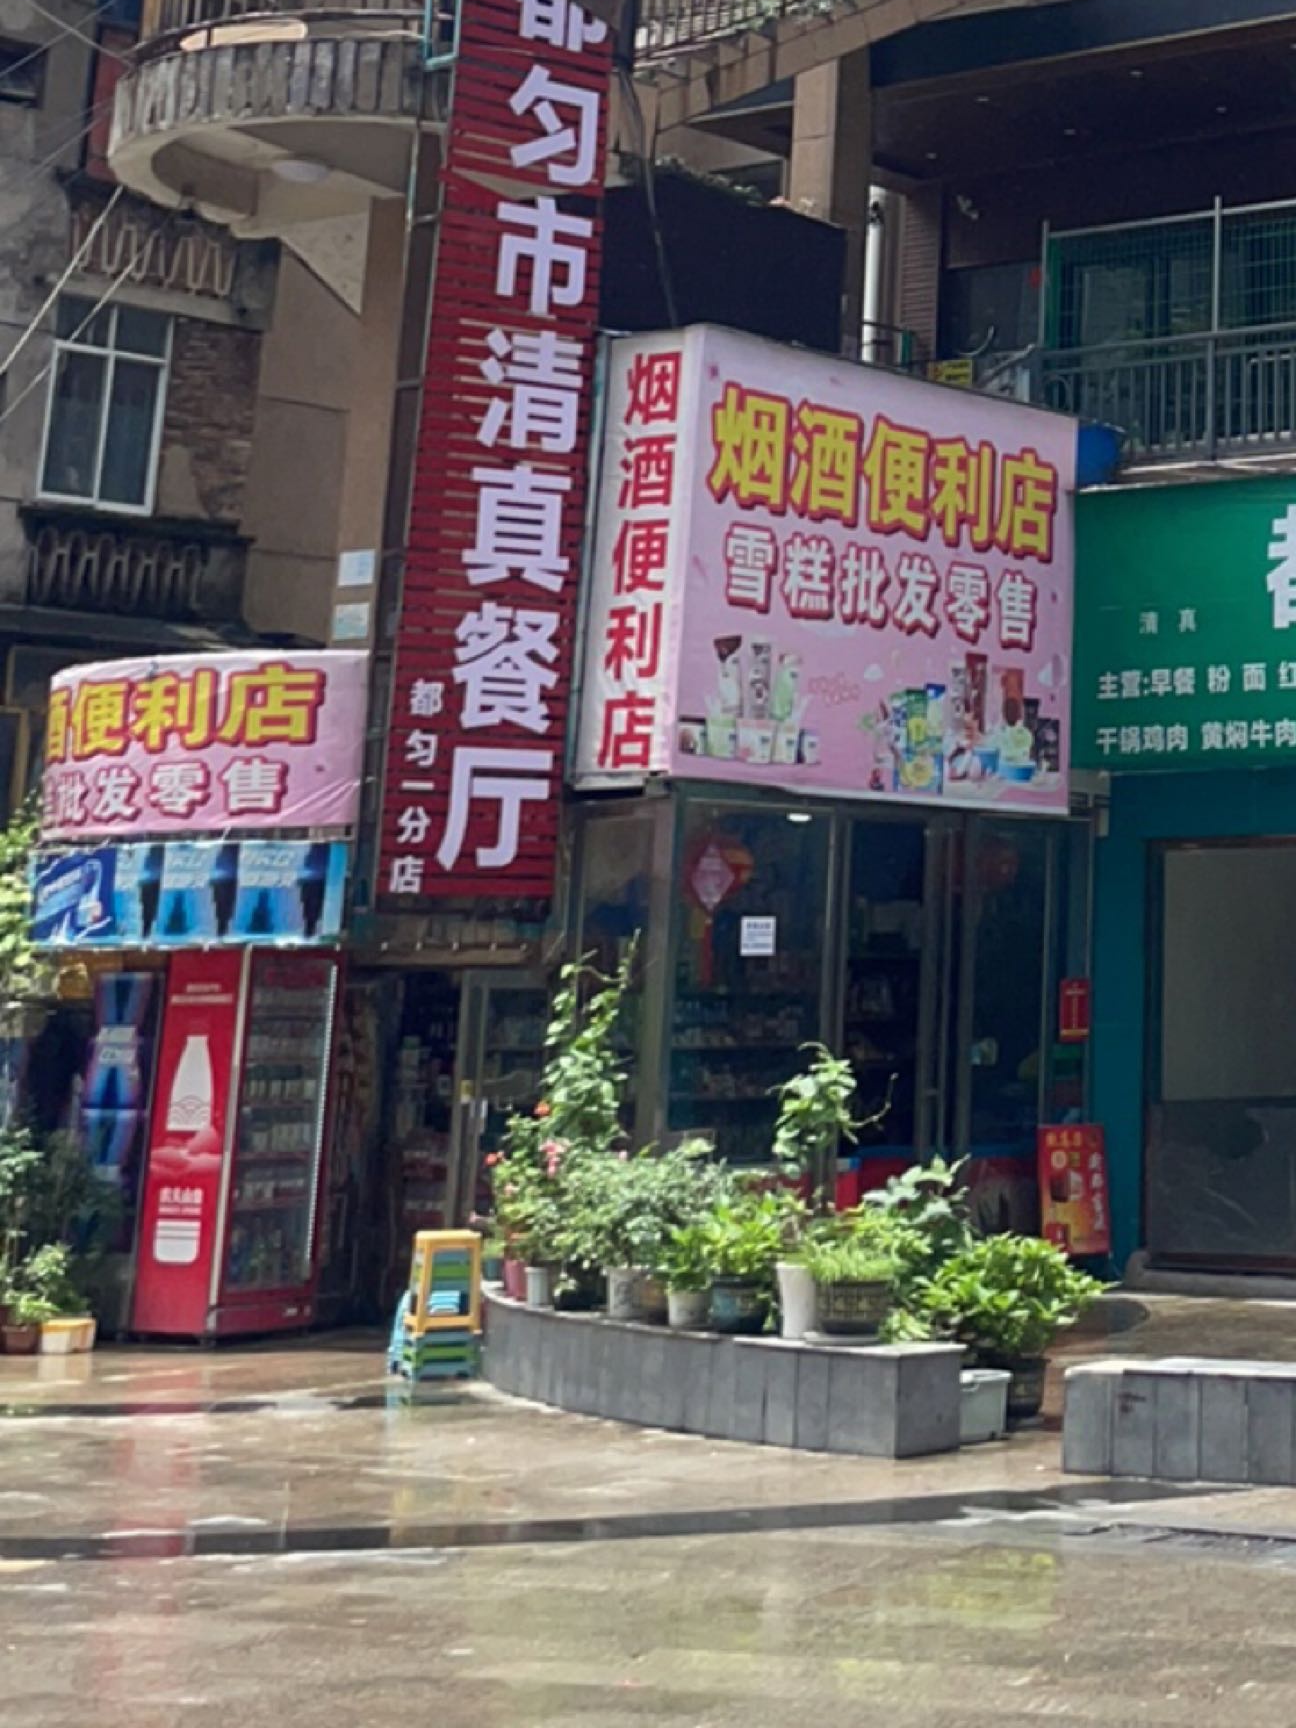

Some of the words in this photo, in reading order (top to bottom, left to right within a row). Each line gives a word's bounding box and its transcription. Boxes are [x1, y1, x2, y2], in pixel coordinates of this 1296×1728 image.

[709, 382, 1057, 561] 烟酒便利店
[599, 351, 682, 770] 烟酒便利店
[725, 523, 1037, 651] 雪糕批发零售
[1242, 661, 1268, 691] 面
[43, 756, 288, 828] 批发零售
[389, 678, 445, 895] 都匀一分店
